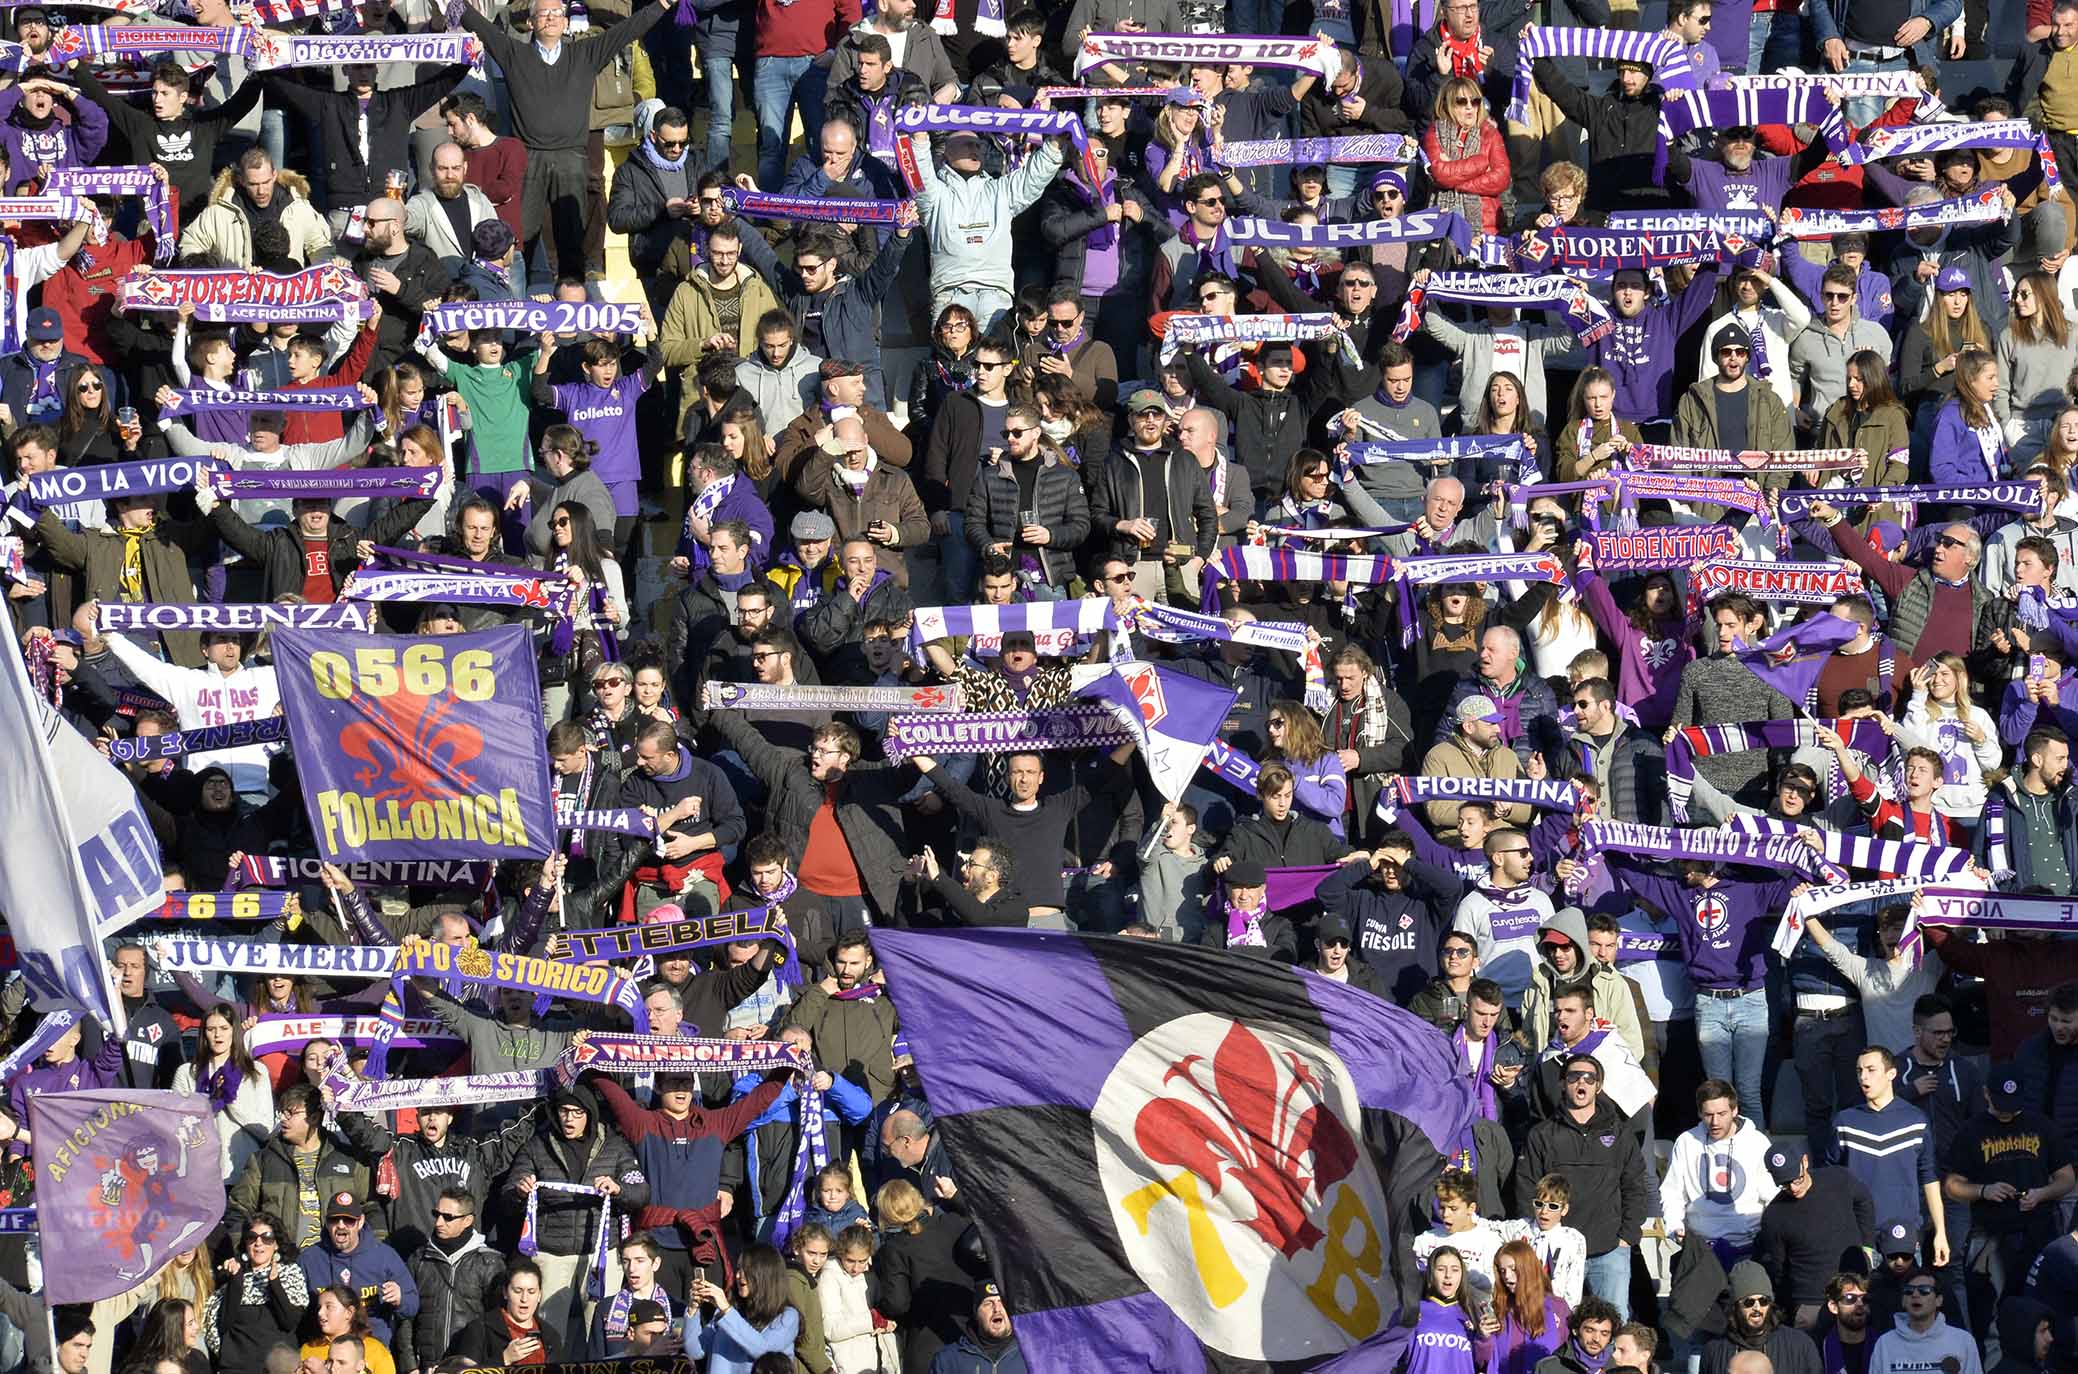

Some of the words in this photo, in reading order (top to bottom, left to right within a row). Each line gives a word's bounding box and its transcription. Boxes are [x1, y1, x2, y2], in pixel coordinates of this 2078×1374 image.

[116, 30, 219, 44] FIORENTINA
[296, 45, 393, 63] ORGOGLIO
[403, 42, 457, 61] VIOLA
[1104, 40, 1242, 58] MAGICO
[1748, 75, 1911, 93] FIORENTINA
[157, 150, 194, 161] adidas
[1222, 212, 1439, 242] ULTRAS
[1551, 231, 1721, 257] FIORENTINA
[1669, 255, 1697, 266] Firenze
[1697, 253, 1715, 263] 1926
[168, 271, 323, 305] FIORENTINA
[232, 308, 258, 318] ACF
[259, 307, 338, 320] FIORENTINA
[555, 303, 641, 333] 2005
[1199, 321, 1264, 340] MAGICA
[1268, 321, 1316, 339] VIOLA
[189, 389, 355, 408] FIORENTINA
[573, 405, 623, 421] folletto
[1653, 446, 1732, 461] FIORENTINA
[1771, 448, 1851, 462] TORINO
[100, 468, 130, 492] LA
[1649, 476, 1676, 488] VIOLA
[1707, 480, 1734, 491] VIOLA
[1936, 485, 2041, 508] FIESOLE
[1597, 534, 1727, 559] FIORENTINA
[306, 551, 328, 577] H
[353, 577, 512, 599] FIORENTINA
[98, 603, 367, 631] FIORENZA
[1157, 610, 1217, 632] Fiorentina
[308, 643, 496, 702] 0566
[751, 687, 785, 700] GRAZIE
[787, 689, 794, 701] A
[816, 689, 837, 701] NON
[898, 716, 1038, 746] COLLETTIVO
[1416, 776, 1576, 807] FIORENTINA
[317, 787, 529, 857] FOLLONICA
[1590, 820, 1673, 850] FIRENZE
[1679, 828, 1738, 857] VANTO
[1745, 832, 1758, 859] E
[270, 857, 477, 884] FIOENTINA
[1938, 897, 2004, 918] VIOLA
[1366, 918, 1387, 934] CURVA
[1360, 931, 1416, 952] FIESOLE
[167, 940, 269, 969] JUVE
[496, 953, 608, 996] STORICO
[375, 1020, 393, 1044] 73
[600, 1043, 733, 1061] FIORENTINA
[1981, 1133, 2040, 1163] THRASHER
[412, 1157, 471, 1183] BROOKLYN
[1121, 1170, 1248, 1310] 7
[1416, 1332, 1474, 1353] TOYOTA
